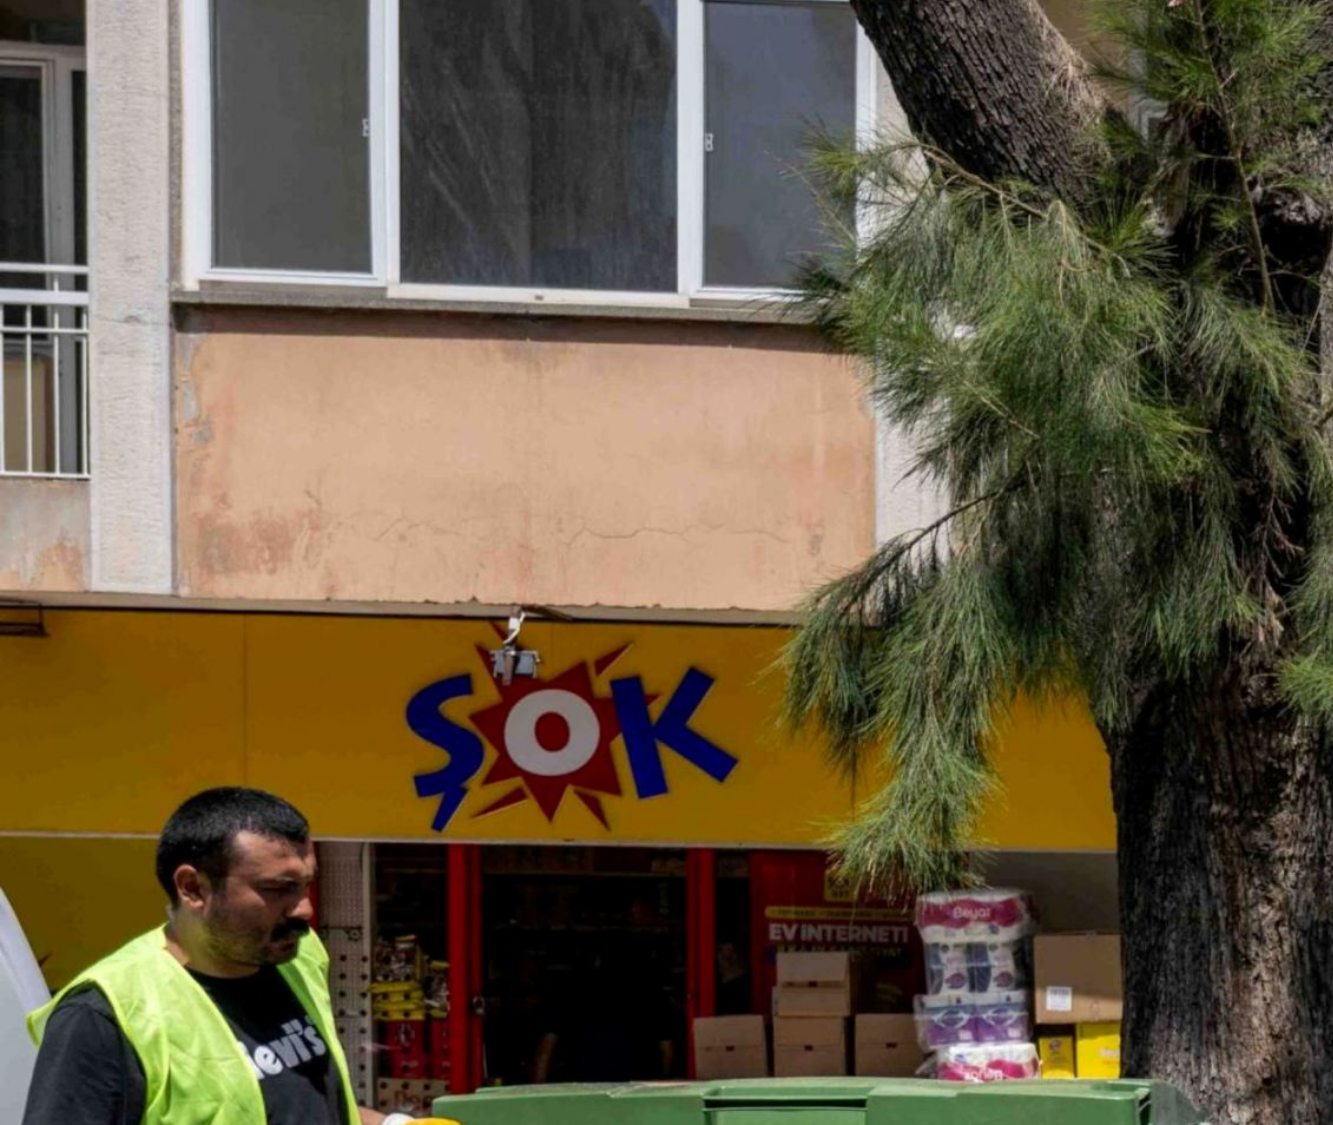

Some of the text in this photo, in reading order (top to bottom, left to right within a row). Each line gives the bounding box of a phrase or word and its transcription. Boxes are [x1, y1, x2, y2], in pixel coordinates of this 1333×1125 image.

[405, 665, 739, 833] ŞOK
[768, 923, 797, 941] EV
[238, 1018, 326, 1079] evi's
